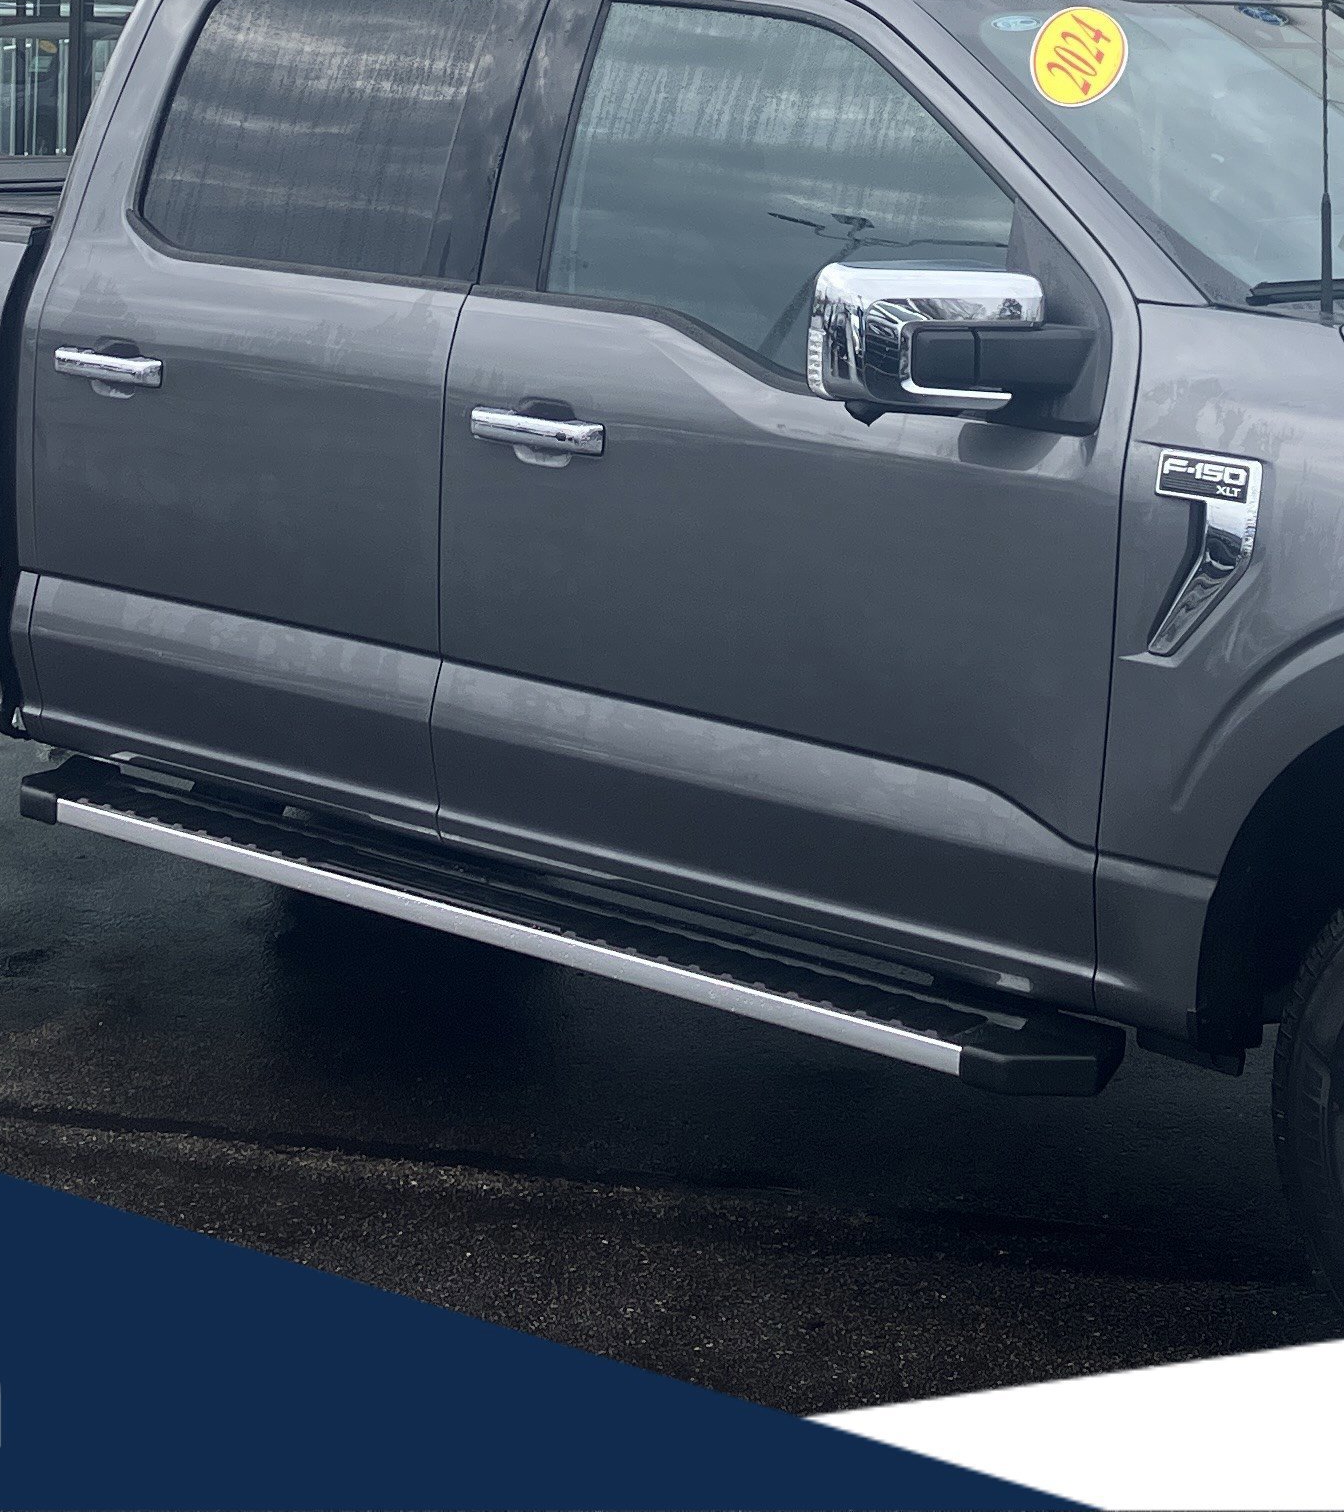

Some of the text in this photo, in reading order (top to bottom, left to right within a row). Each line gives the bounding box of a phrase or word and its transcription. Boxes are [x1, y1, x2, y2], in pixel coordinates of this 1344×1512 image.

[1046, 13, 1112, 96] 2024
[1162, 457, 1248, 487] F-150
[1216, 484, 1242, 498] XLT
